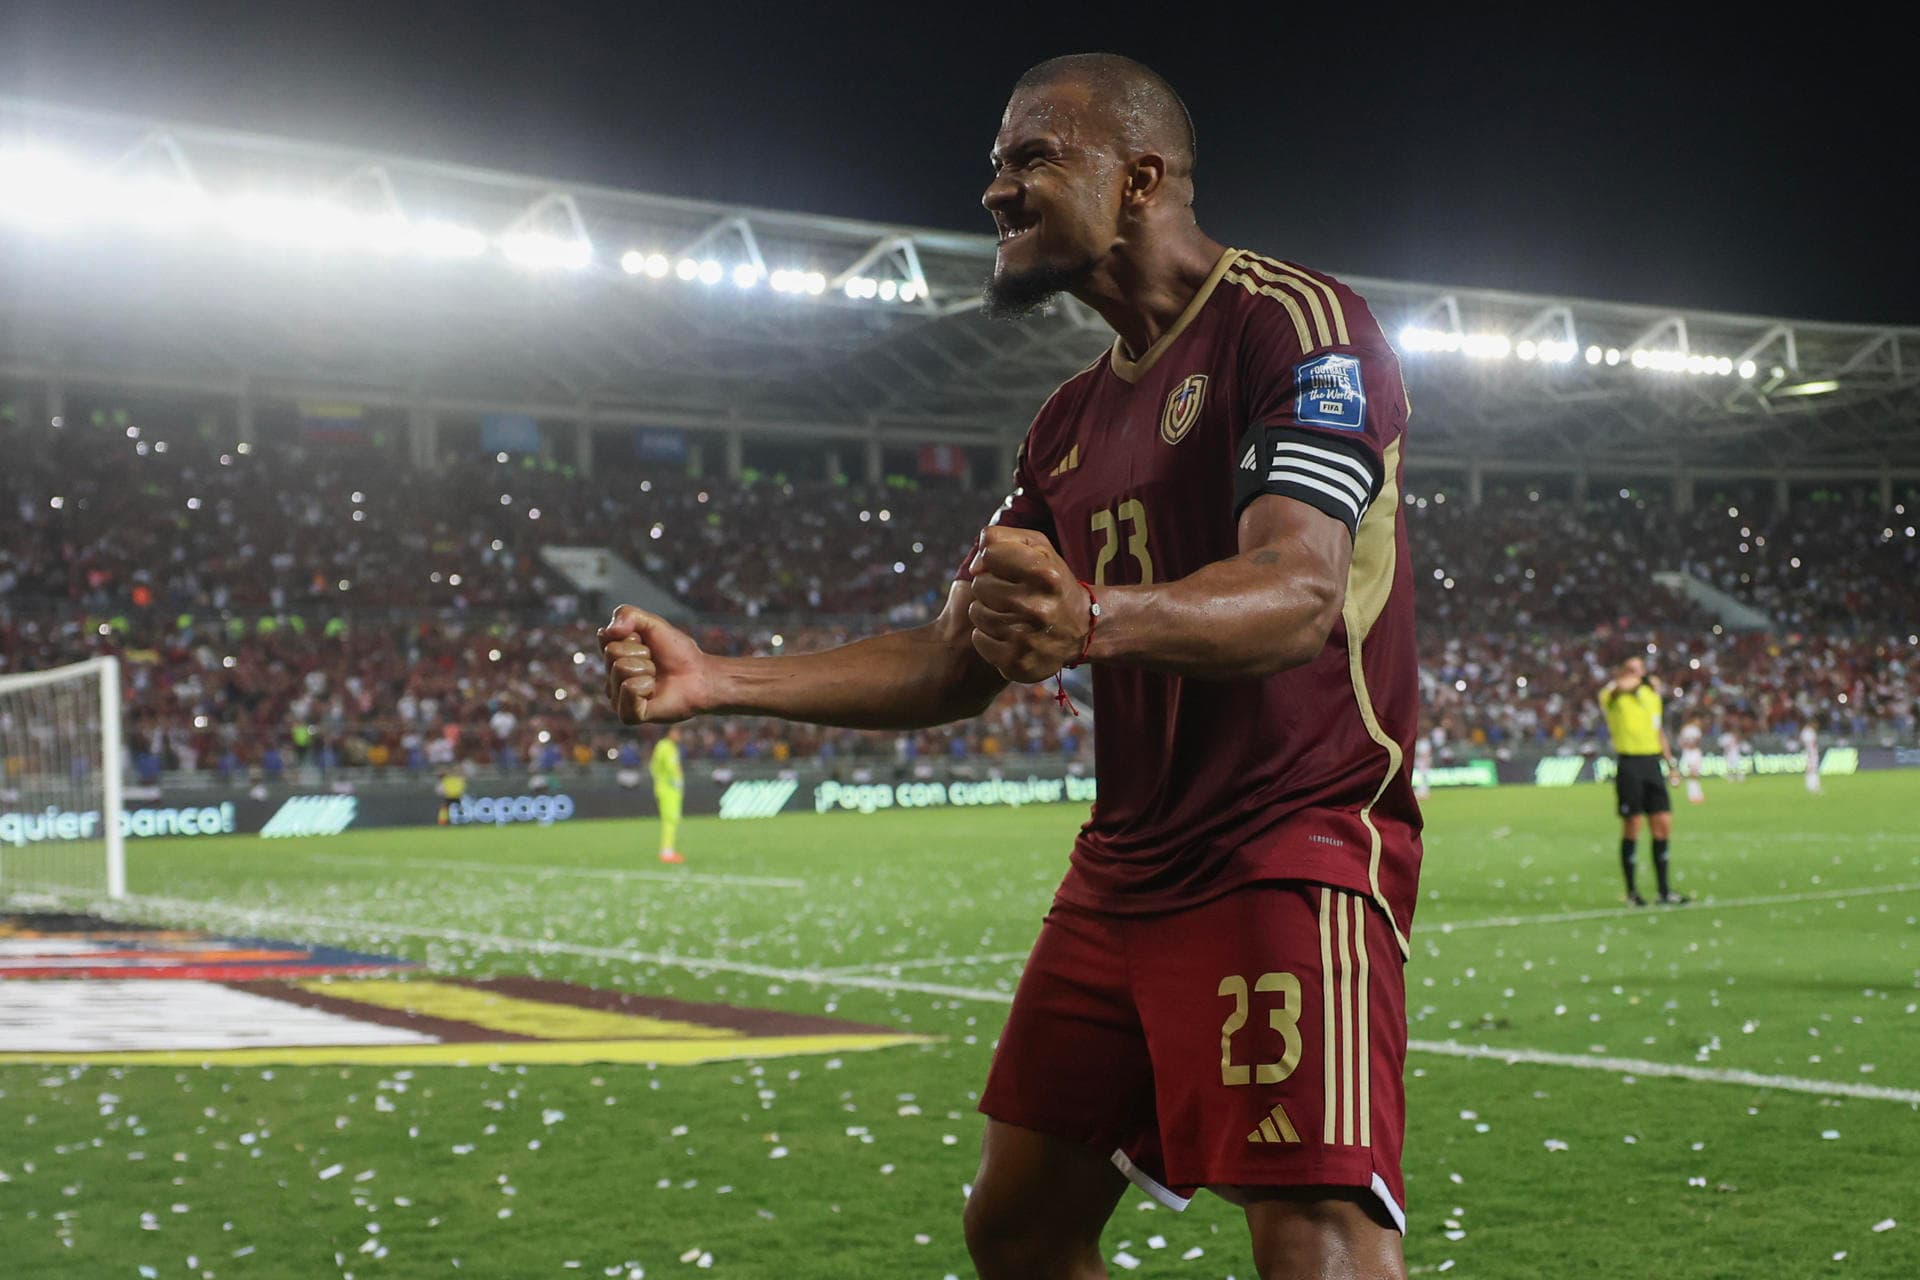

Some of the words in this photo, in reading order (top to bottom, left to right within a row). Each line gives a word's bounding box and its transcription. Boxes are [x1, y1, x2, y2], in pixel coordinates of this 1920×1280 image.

[1311, 374, 1351, 389] UNITES
[1309, 389, 1326, 401] the
[1326, 388, 1353, 402] World
[1322, 403, 1340, 412] FIFA
[1091, 498, 1154, 585] 23
[1218, 972, 1302, 1085] 23
